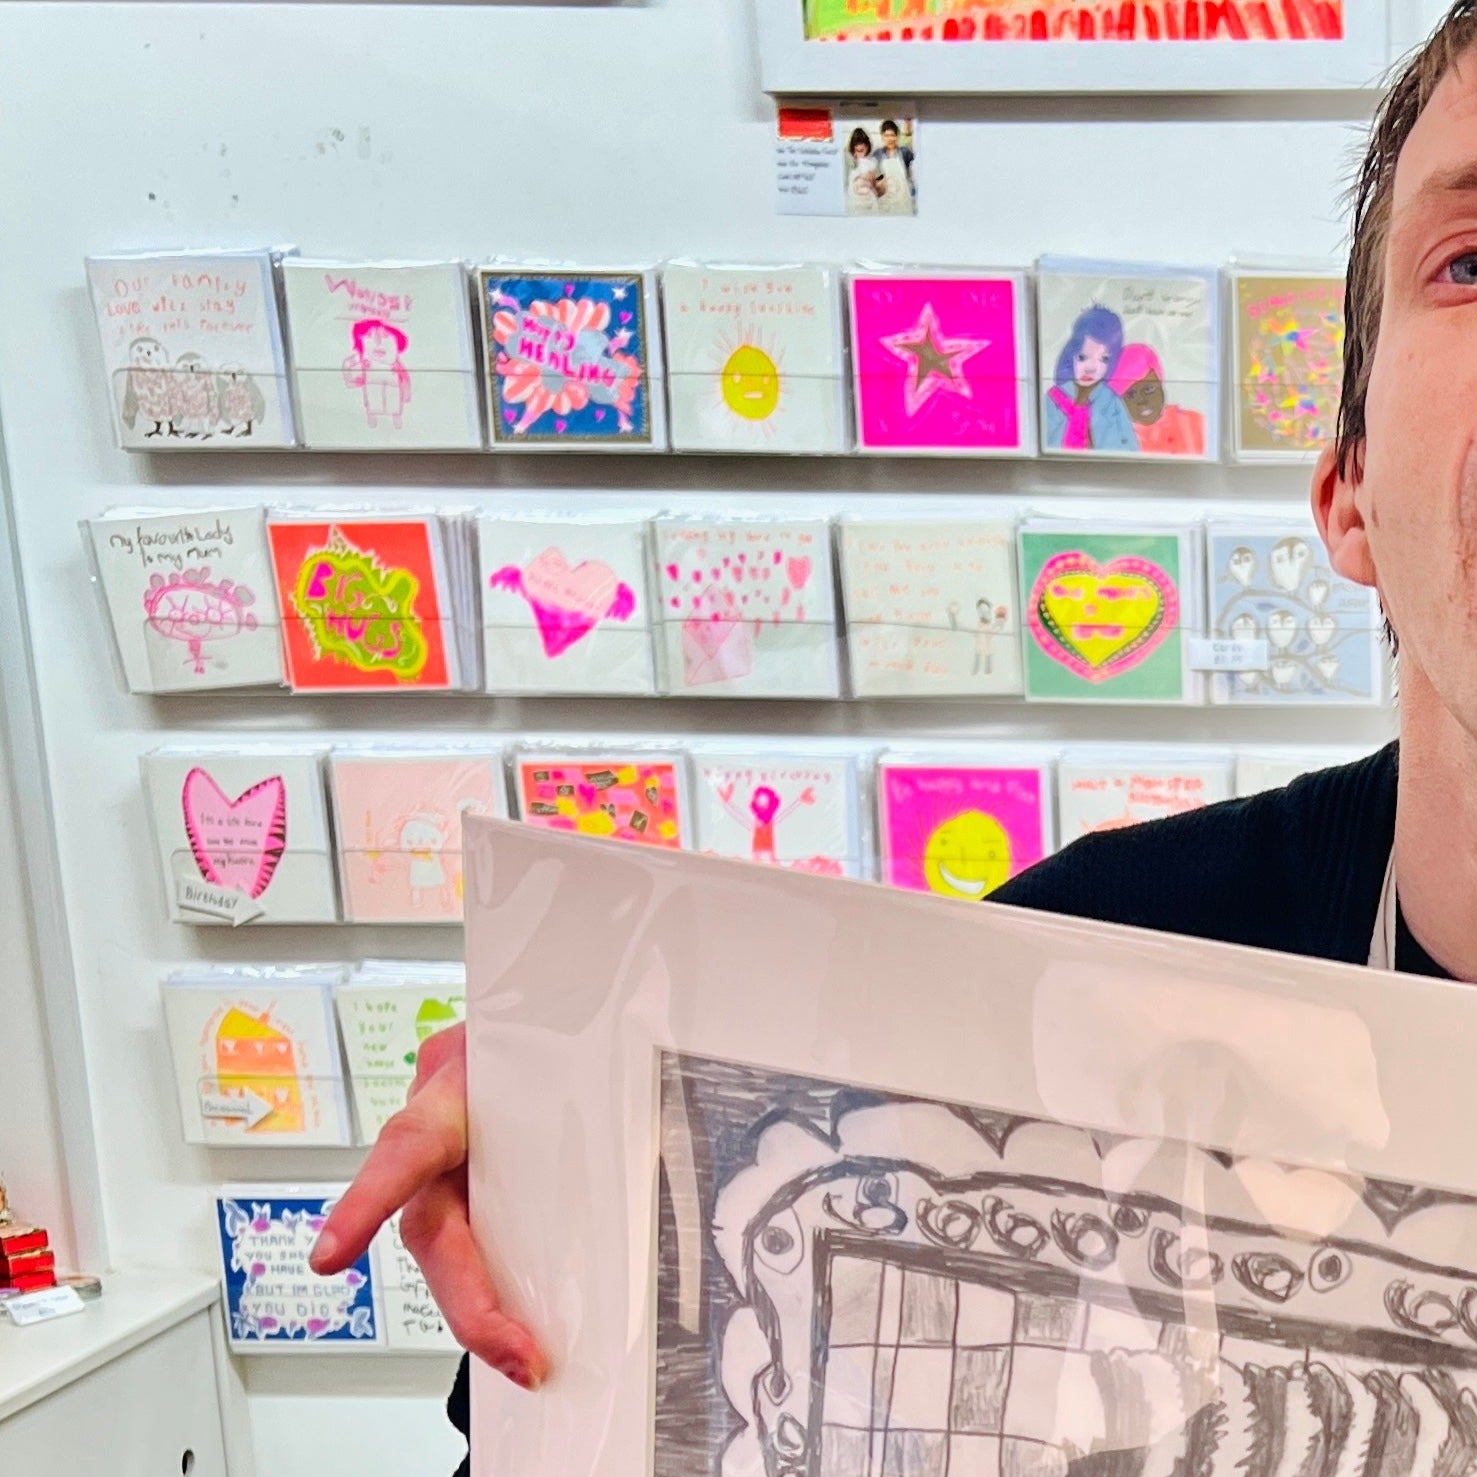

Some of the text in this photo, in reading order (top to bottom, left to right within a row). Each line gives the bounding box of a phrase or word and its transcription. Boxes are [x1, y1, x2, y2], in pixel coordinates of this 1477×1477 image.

[326, 609, 402, 658] HUGS
[184, 884, 239, 909] Birthday
[249, 1234, 296, 1247] THANK
[255, 1284, 283, 1297] BUT
